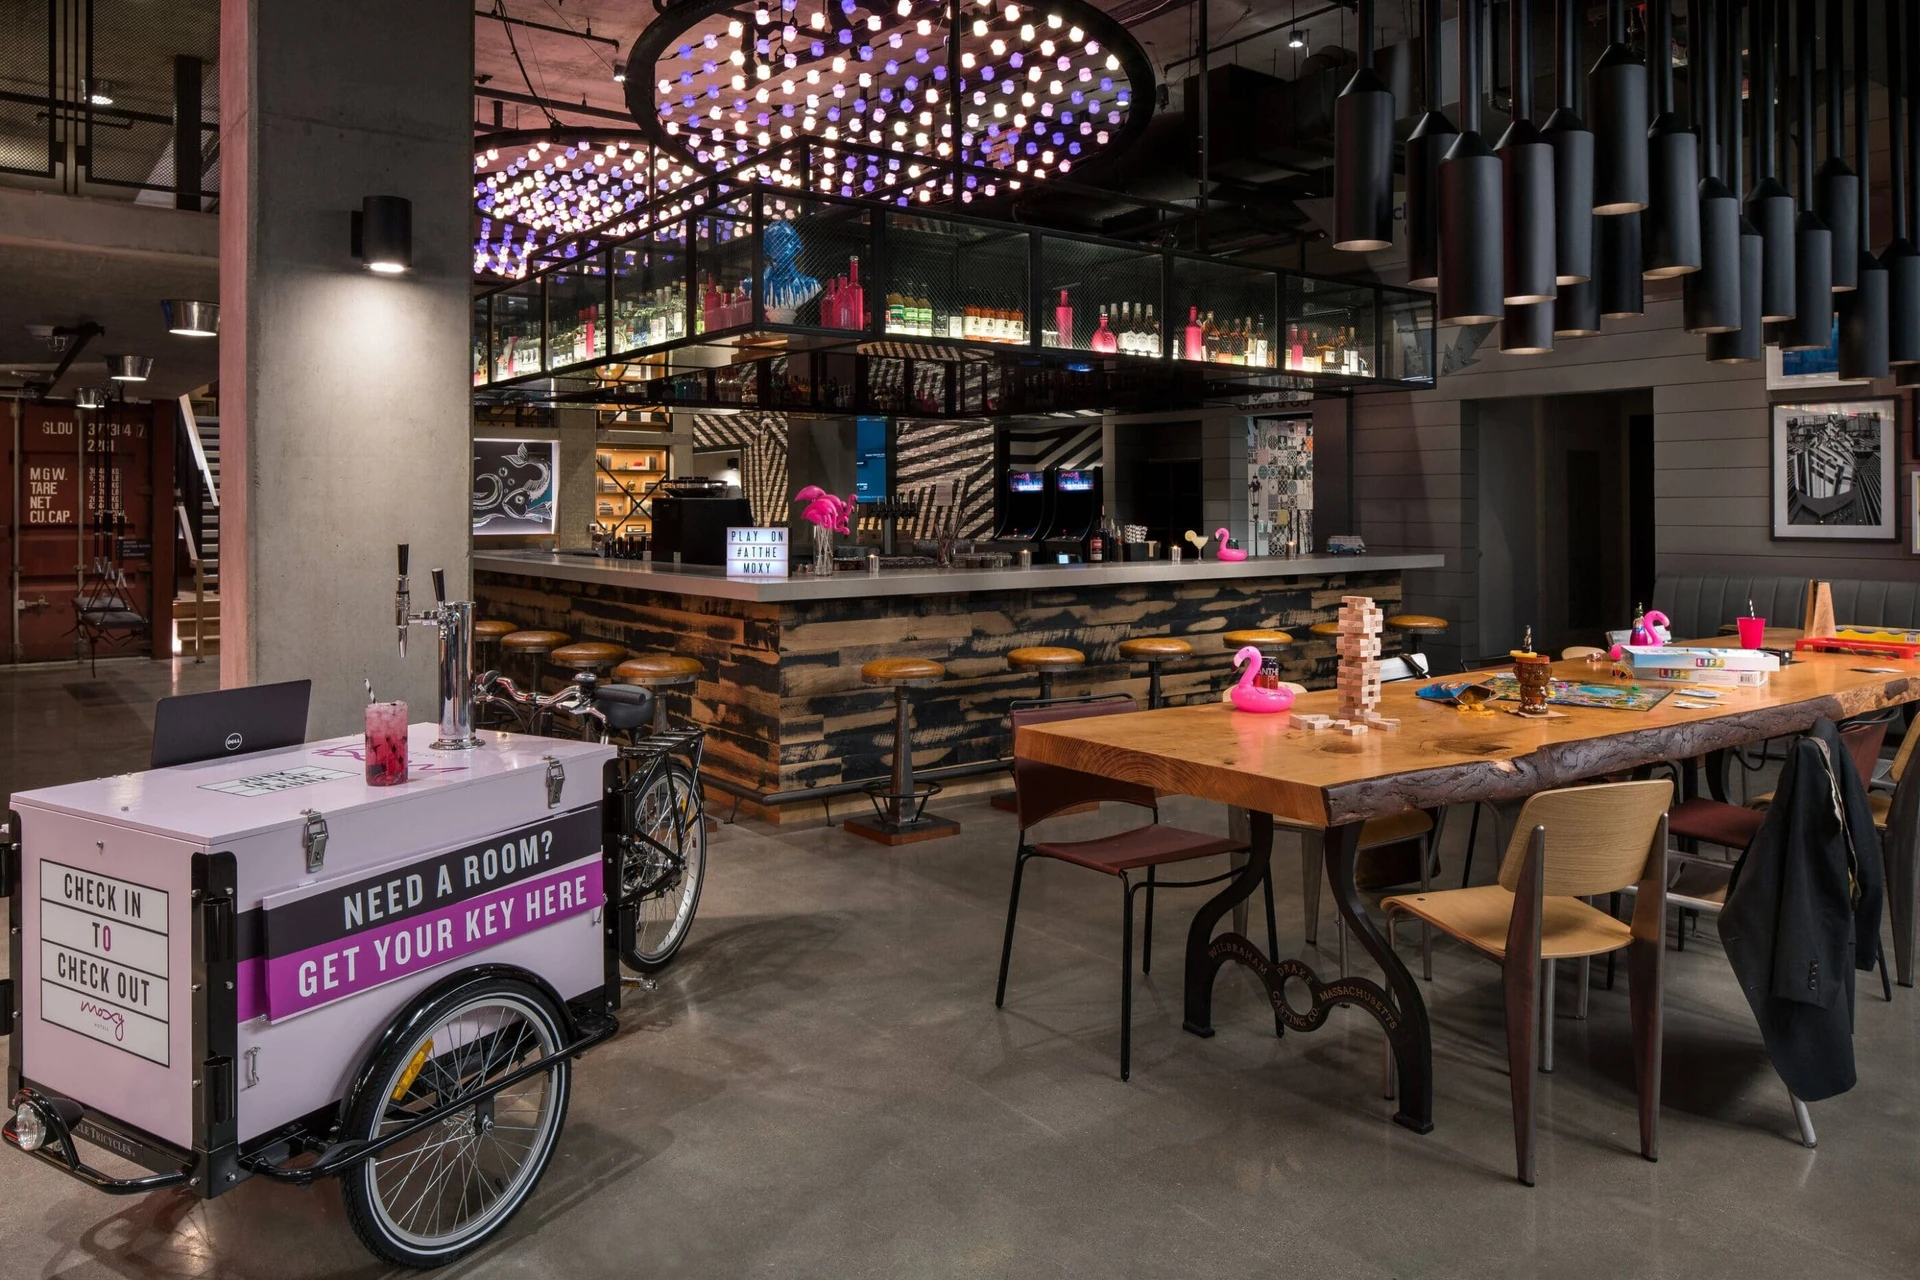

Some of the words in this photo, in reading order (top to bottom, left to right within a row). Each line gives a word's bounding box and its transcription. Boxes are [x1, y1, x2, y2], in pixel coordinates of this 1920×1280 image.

[42, 421, 73, 435] GLDU
[88, 423, 132, 437] 3734
[30, 481, 58, 495] TARE
[30, 496, 52, 509] NET
[731, 530, 758, 542] PLAY
[771, 530, 784, 542] ON
[737, 546, 777, 558] #ATTHE
[743, 562, 771, 574] MOXY
[1659, 668, 1689, 679] LIFE
[1696, 658, 1725, 668] LIFE
[343, 873, 423, 930] NEED
[436, 864, 453, 898] A
[463, 830, 553, 888] ROOM?
[64, 873, 117, 912] CHECK
[124, 889, 141, 919] IN
[91, 921, 112, 952] TO
[298, 945, 360, 998] GET
[374, 918, 453, 972] YOUR
[465, 898, 516, 943] KEY
[526, 875, 587, 923] HERE
[1208, 940, 1268, 976] WILBRAHAM
[57, 952, 110, 994] CHECK
[117, 972, 150, 1007] OUT
[1276, 963, 1313, 985] DRAKE
[1272, 991, 1306, 1027] CASTING
[1319, 985, 1398, 1030] MASSACHUSETTS
[80, 1000, 125, 1042] moxy
